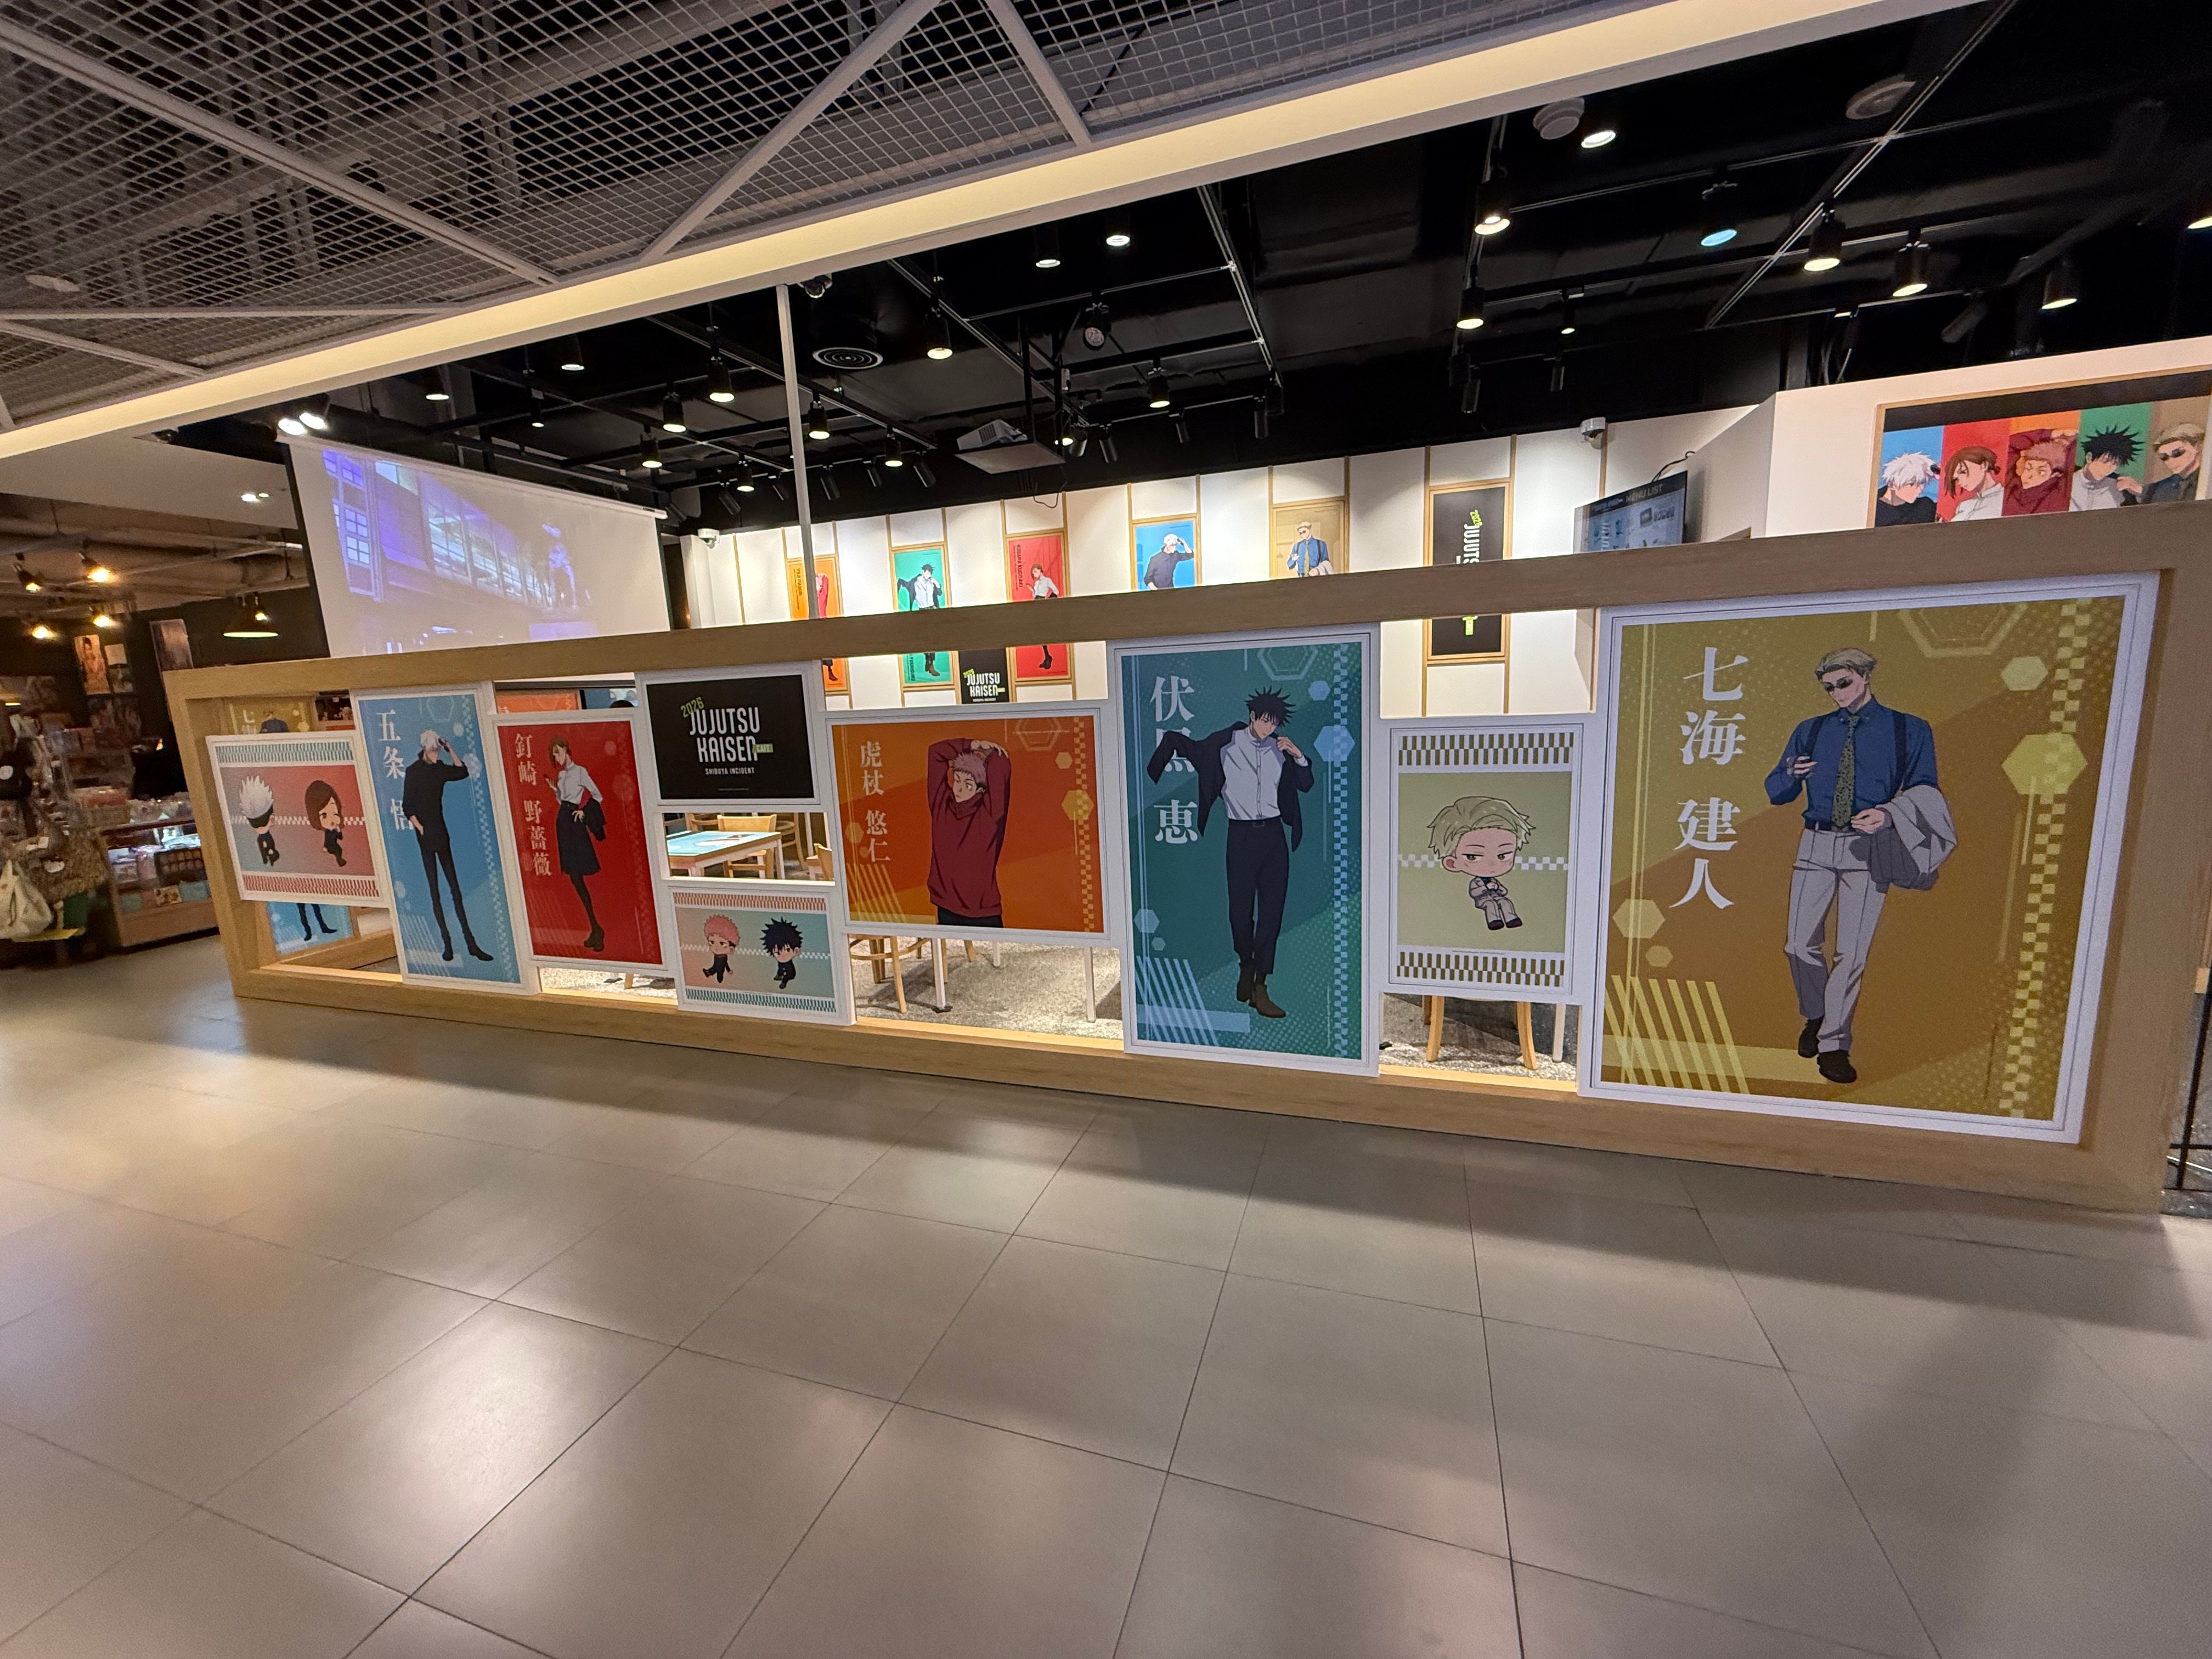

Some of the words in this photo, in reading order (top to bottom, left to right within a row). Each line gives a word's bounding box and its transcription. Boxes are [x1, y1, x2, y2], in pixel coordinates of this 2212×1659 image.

[1626, 489, 1645, 502] MENU
[1647, 484, 1663, 497] LIST
[1463, 523, 1480, 563] JUJUTS
[967, 673, 1000, 686] JUJUTSU
[969, 685, 999, 698] KAISEN
[680, 697, 704, 718] 2026
[690, 707, 760, 736] JUJUTSU
[1680, 647, 1749, 765] 七海
[377, 708, 406, 779] 五条
[515, 733, 538, 786] 釘崎
[697, 736, 758, 763] KAISEN
[860, 741, 885, 796] 虎杖
[523, 799, 552, 877] 野薔薇
[865, 810, 891, 863] 悠仁
[1153, 799, 1198, 844] 恵
[1669, 797, 1741, 910] 建人
